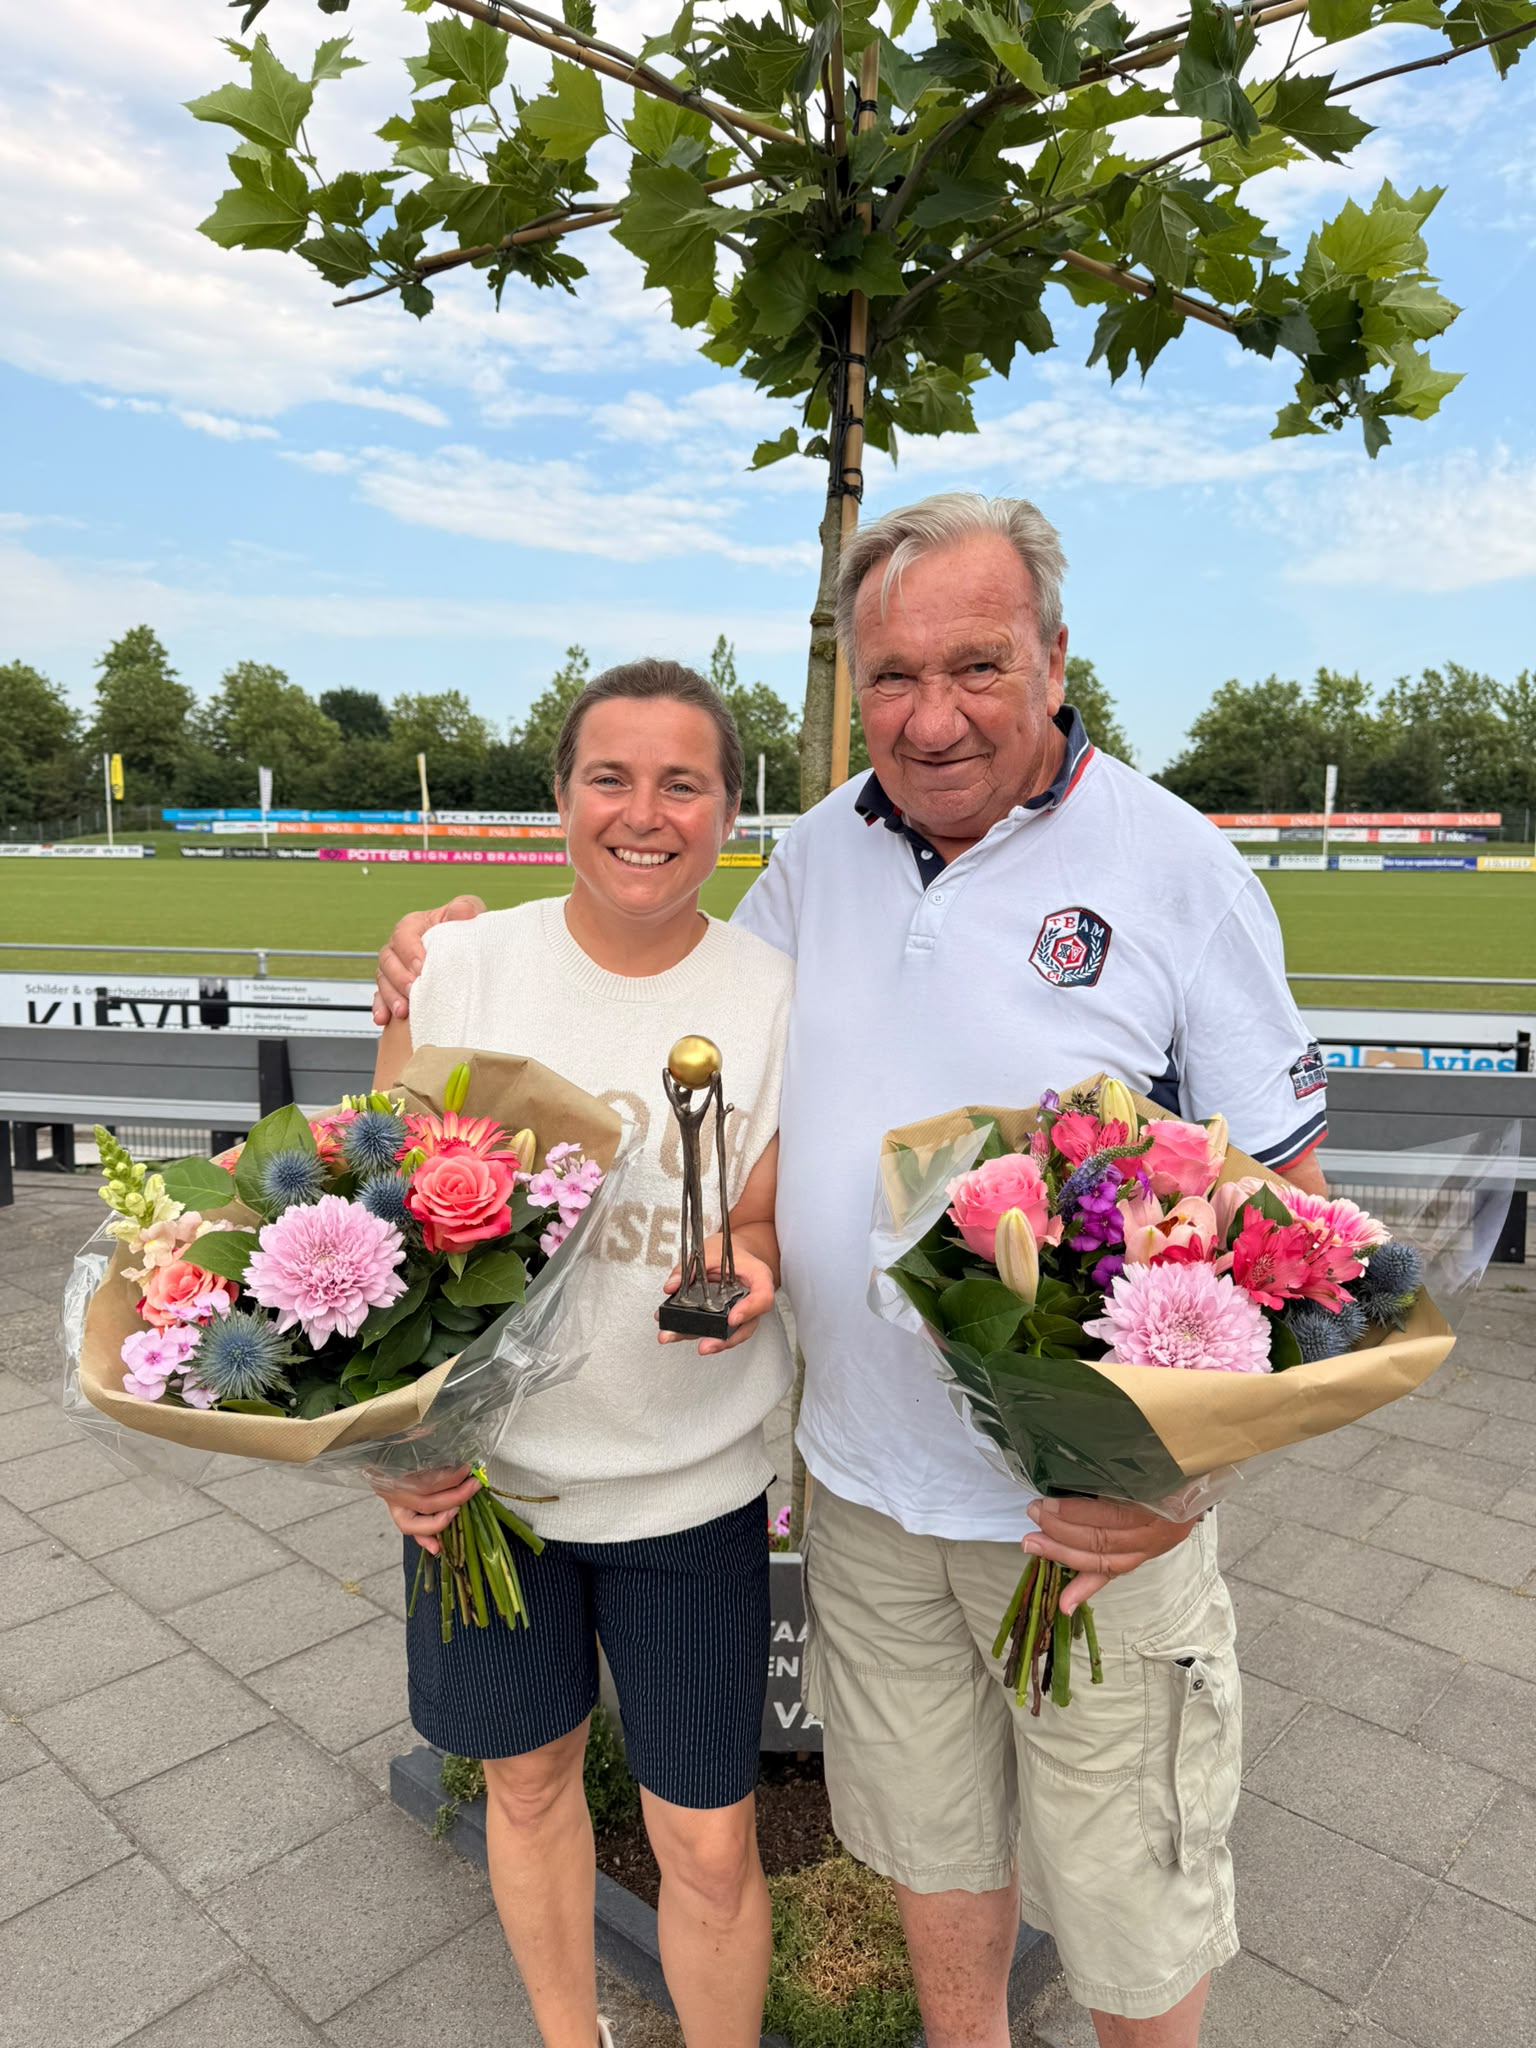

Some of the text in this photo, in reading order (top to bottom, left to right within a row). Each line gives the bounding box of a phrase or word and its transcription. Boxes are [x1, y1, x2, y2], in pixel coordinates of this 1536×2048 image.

[440, 814, 559, 824] FCL MARINE
[347, 850, 564, 862] POTTER SIGN AND BRANDING
[1049, 917, 1105, 938] TEAM
[25, 984, 68, 995] Schilder
[73, 986, 81, 995] &
